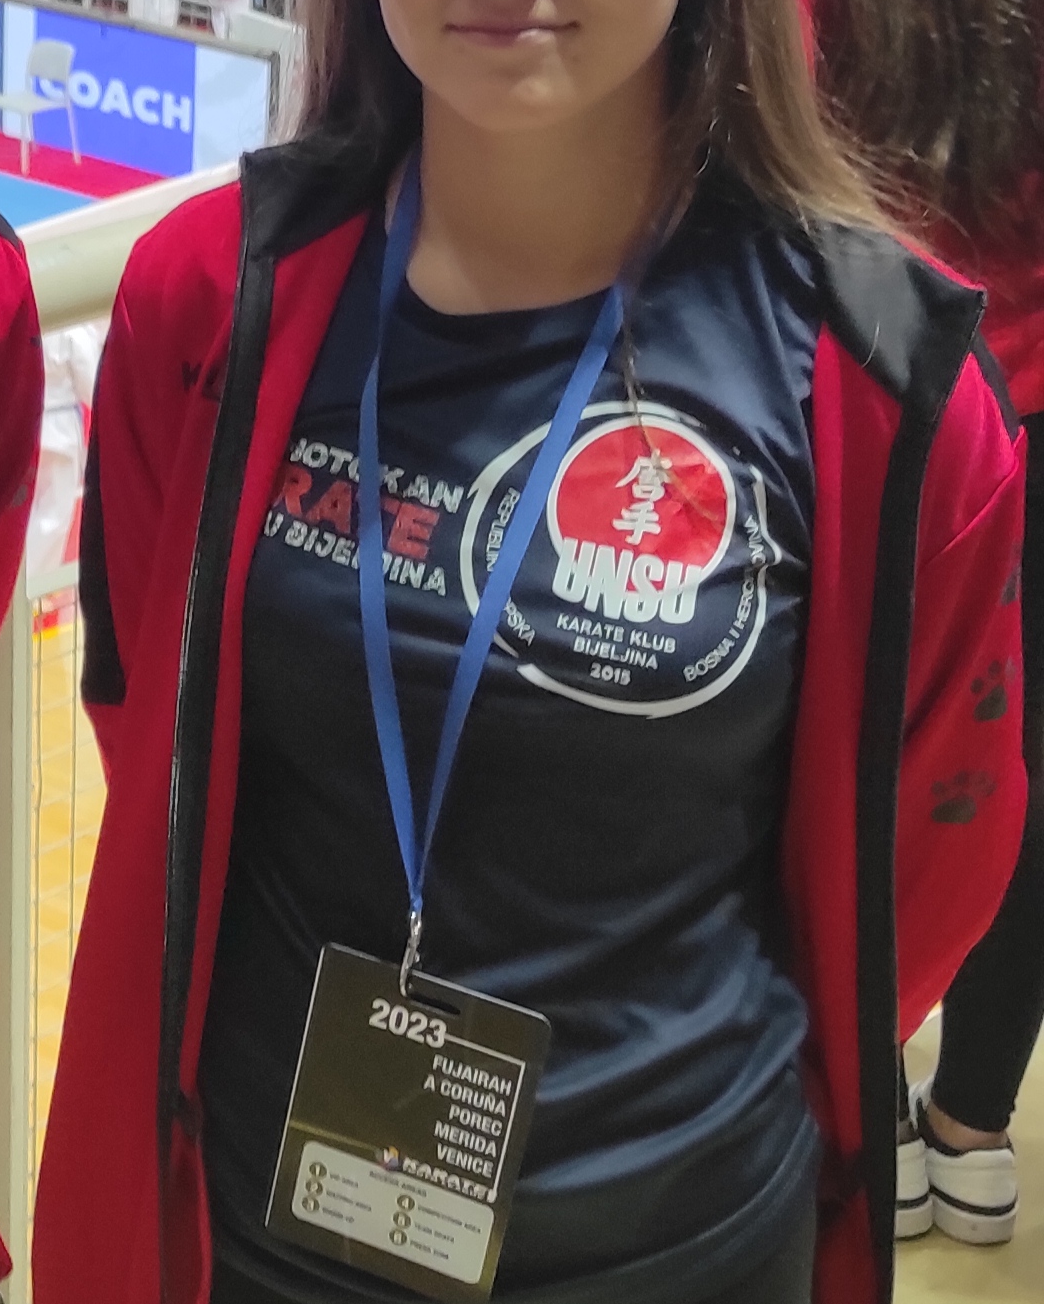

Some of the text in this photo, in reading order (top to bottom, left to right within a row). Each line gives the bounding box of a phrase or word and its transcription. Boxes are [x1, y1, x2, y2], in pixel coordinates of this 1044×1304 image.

[551, 537, 704, 625] UNSU
[556, 612, 677, 654] KARATE KLUB
[573, 635, 659, 671] BIJELJINA
[682, 636, 735, 683] BOSNA
[589, 662, 632, 686] 2015
[368, 997, 447, 1049] 2023
[423, 1073, 436, 1092] A
[432, 1053, 512, 1097] FUJAIRAH
[433, 1119, 498, 1158] MERIDA
[448, 1103, 503, 1137] POREC
[436, 1142, 494, 1179] VENICE
